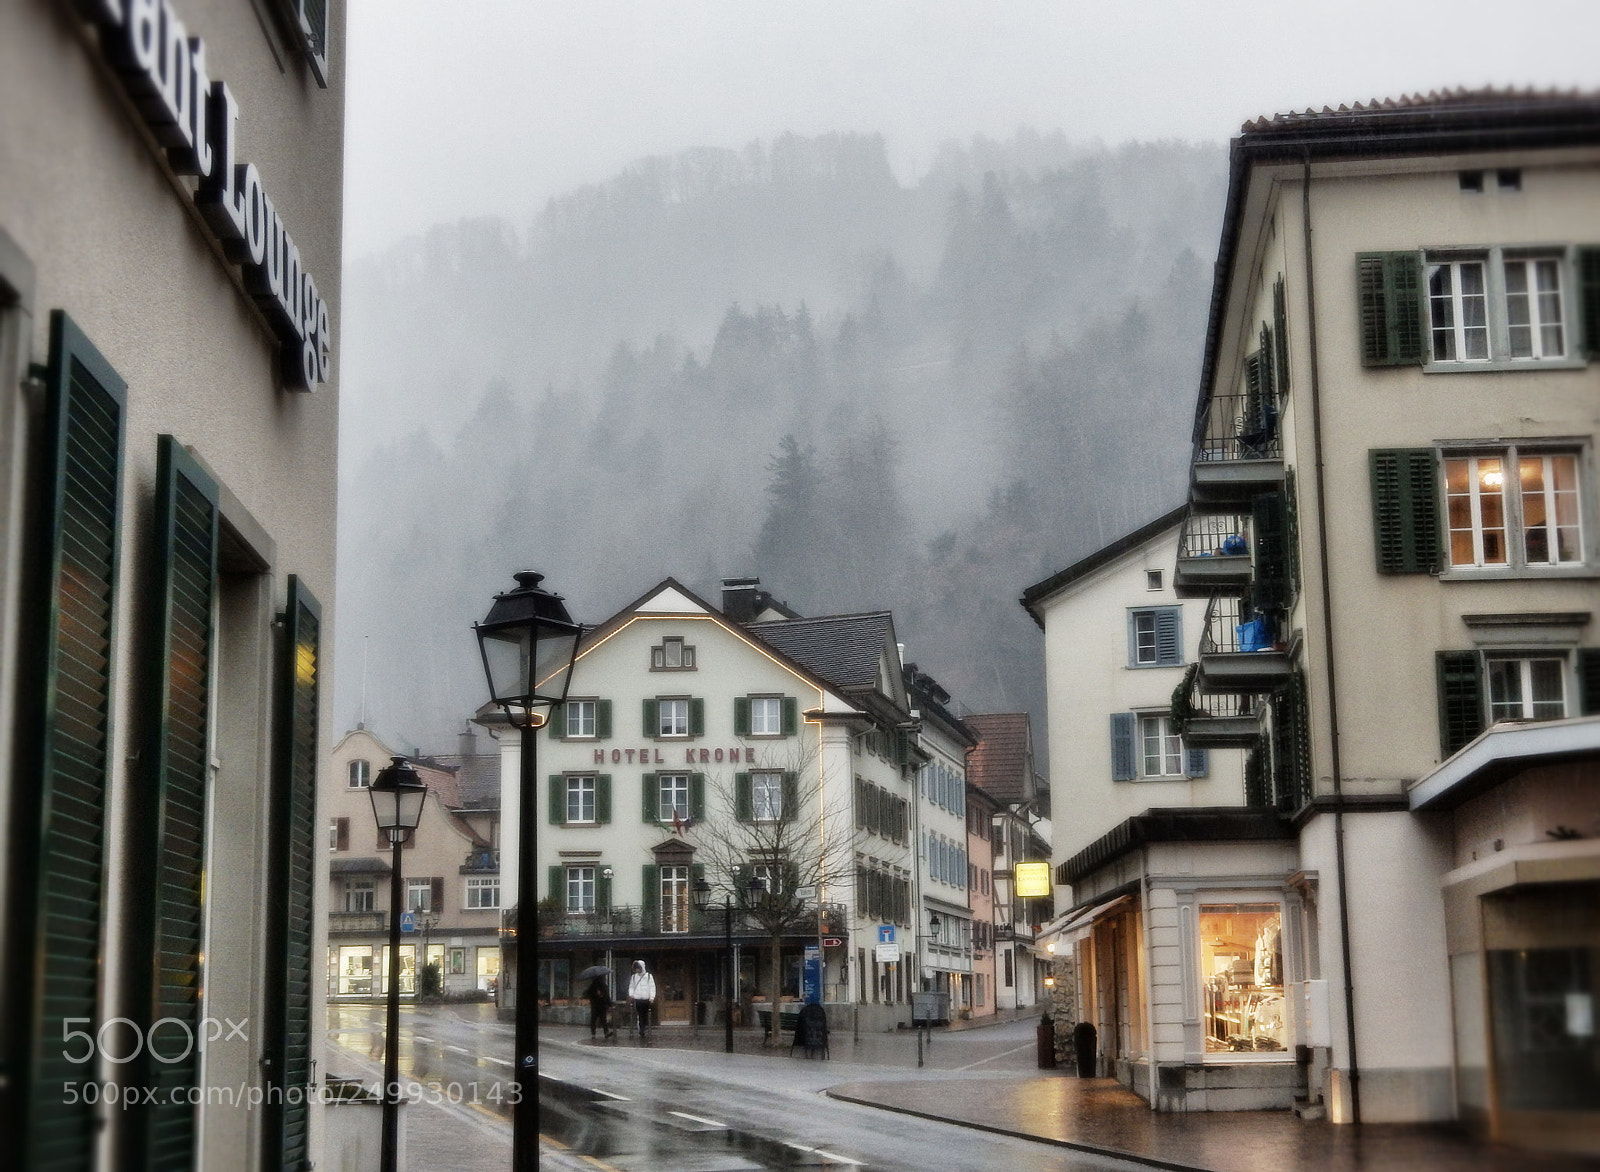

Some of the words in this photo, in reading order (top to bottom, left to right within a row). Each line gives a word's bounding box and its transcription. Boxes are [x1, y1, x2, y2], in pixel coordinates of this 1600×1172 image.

[104, 0, 212, 177] ant
[222, 81, 330, 393] Lounge
[594, 748, 664, 763] HOTEL
[685, 747, 756, 763] KRONE
